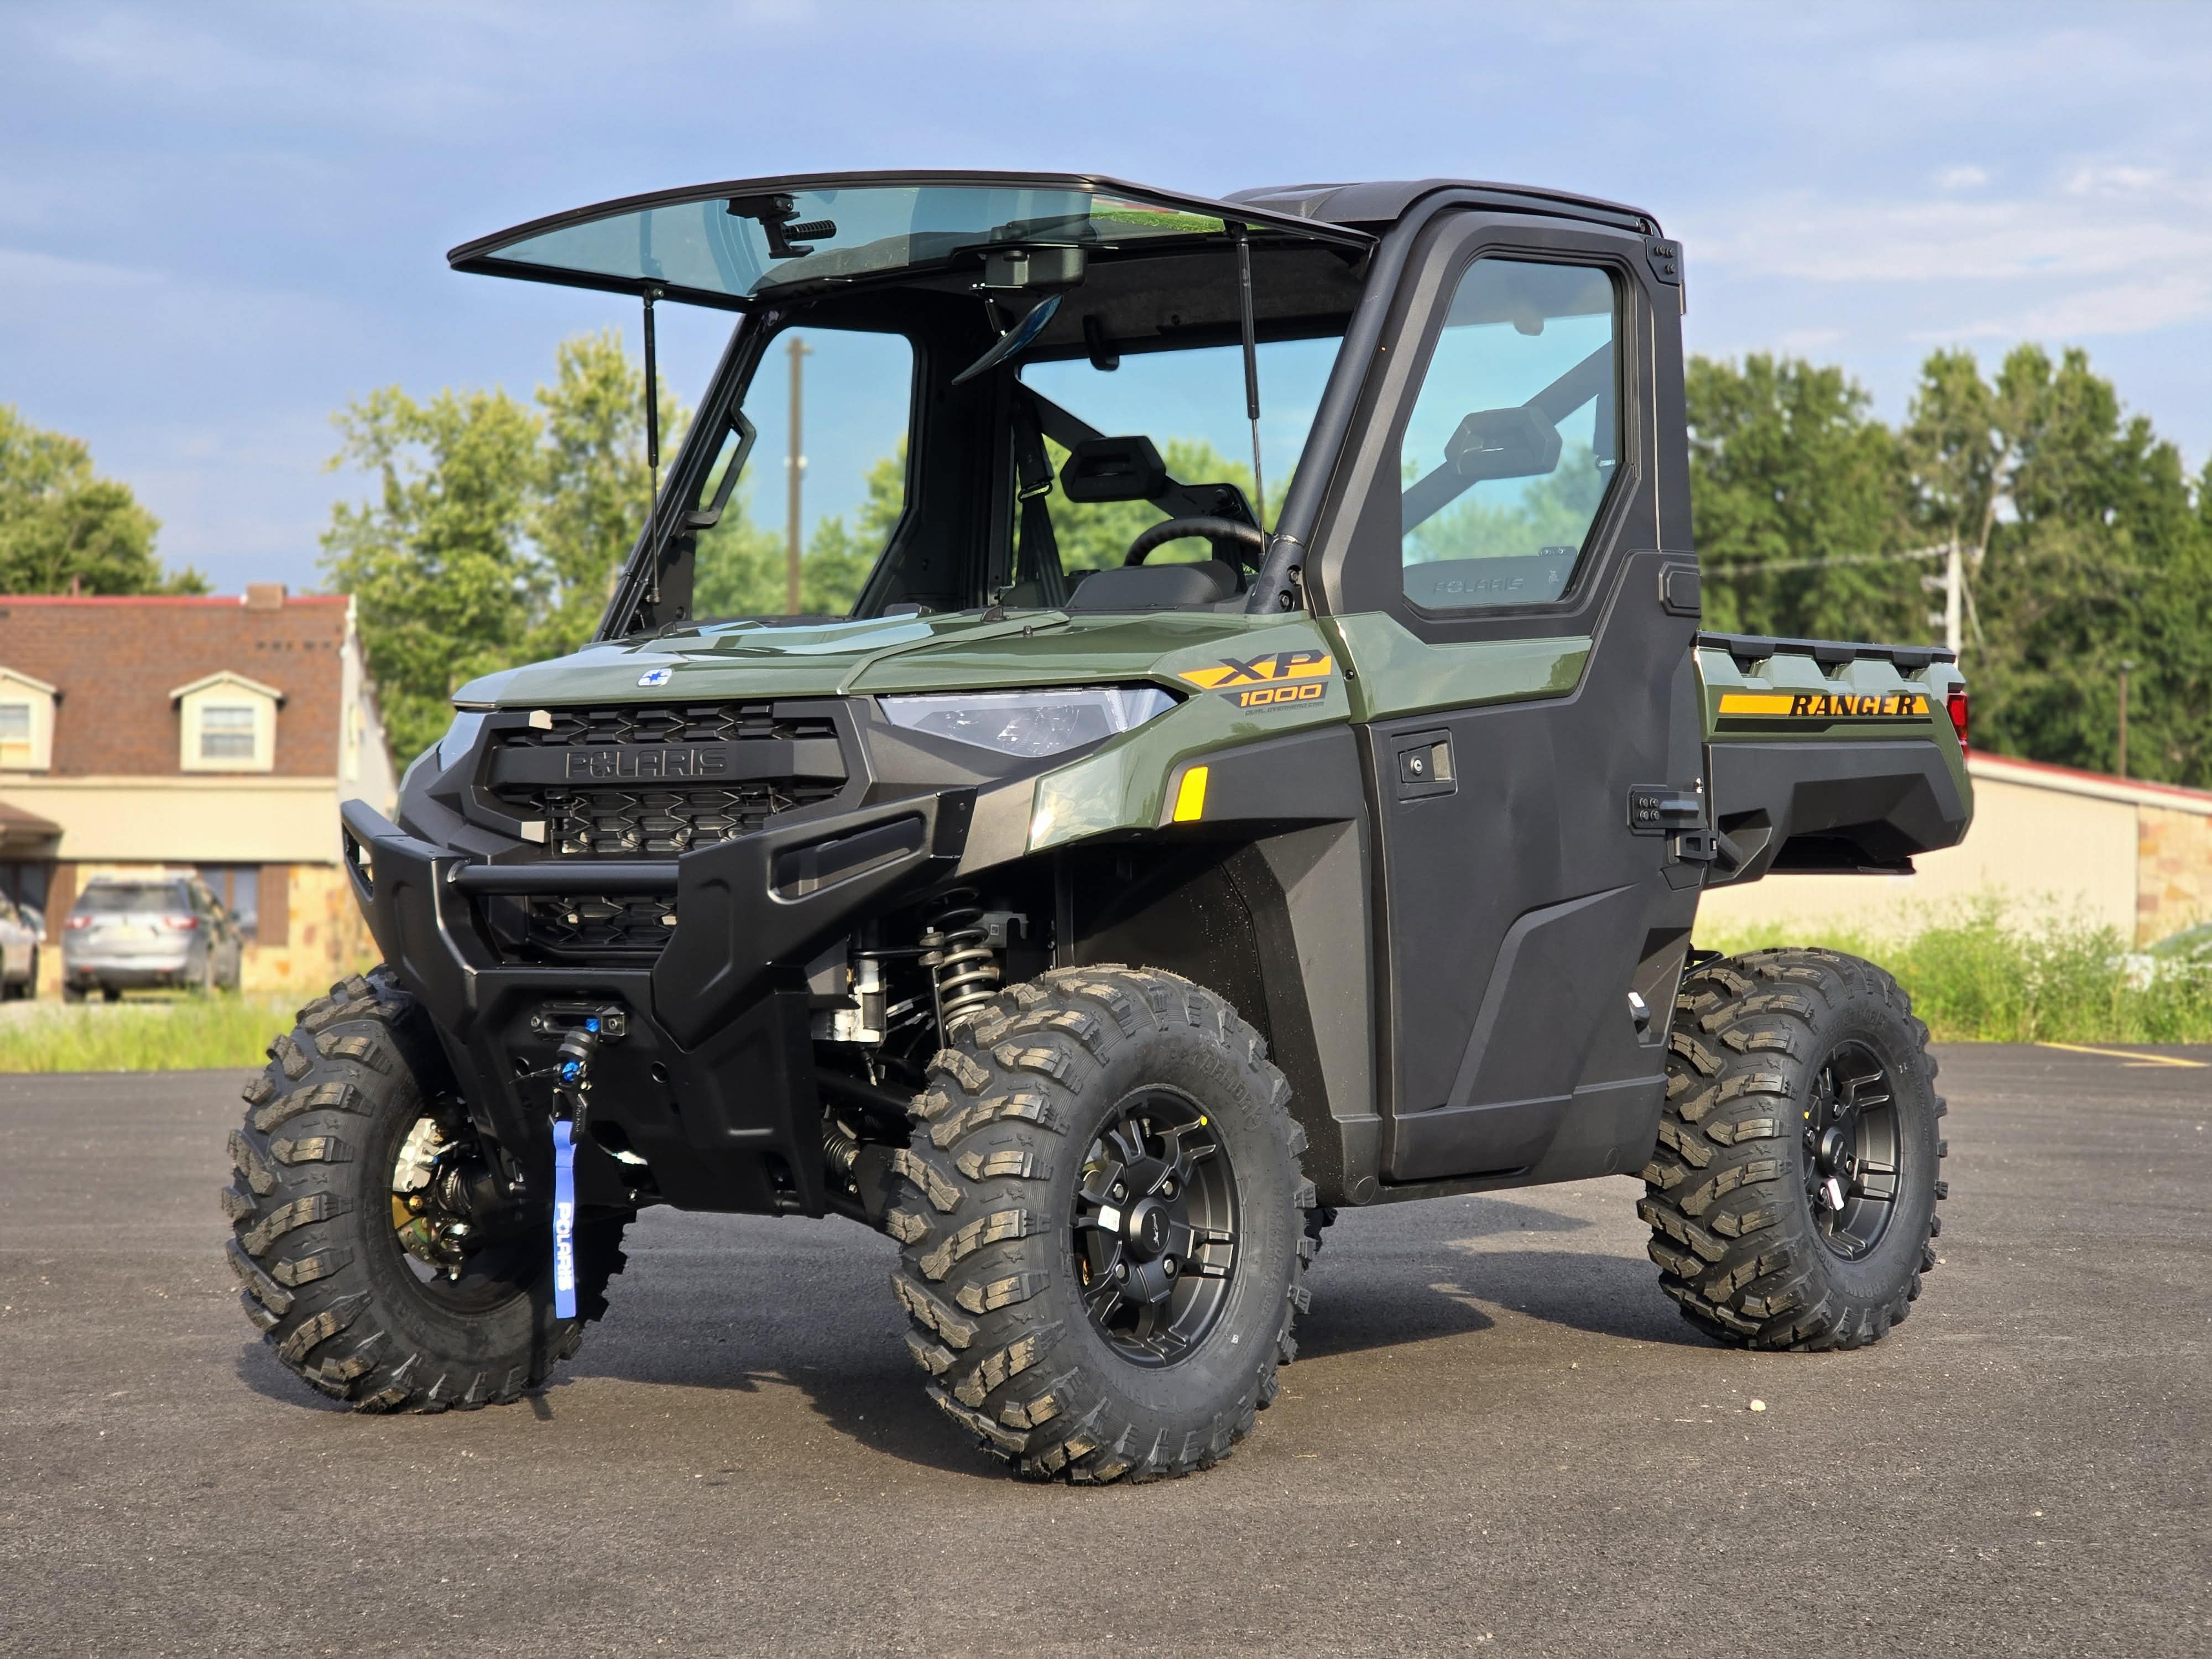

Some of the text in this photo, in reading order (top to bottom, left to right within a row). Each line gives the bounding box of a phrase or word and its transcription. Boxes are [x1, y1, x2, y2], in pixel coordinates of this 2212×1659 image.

[1433, 576, 1525, 596] POLARIS
[1211, 649, 1326, 687] XP
[1240, 684, 1322, 707] 1000
[1788, 693, 1917, 717] RANGER
[1245, 708, 1265, 717] DUAL
[1267, 703, 1307, 713] OVERHEAD
[565, 747, 728, 779] POLARIS
[556, 1202, 572, 1291] POLARIS
